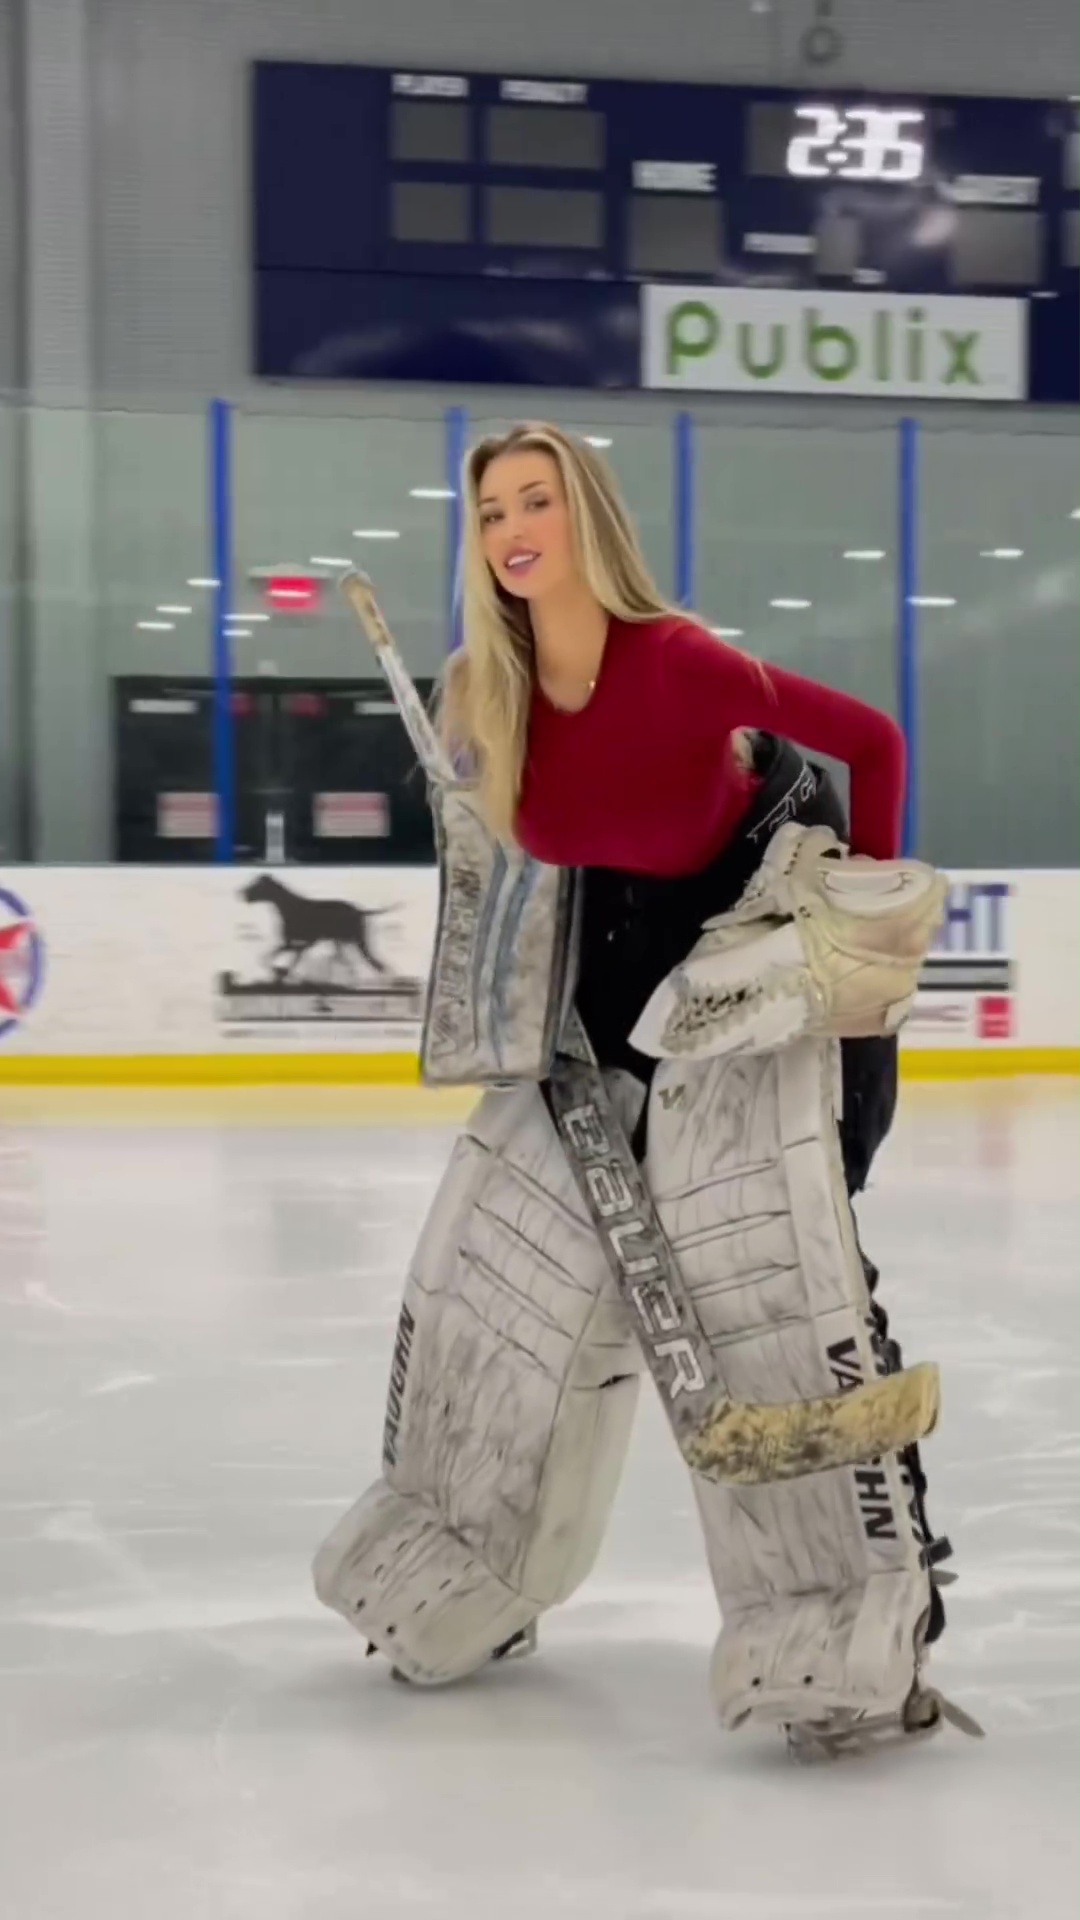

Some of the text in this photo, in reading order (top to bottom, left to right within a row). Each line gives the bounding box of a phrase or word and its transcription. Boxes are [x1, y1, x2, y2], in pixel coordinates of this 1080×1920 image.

[787, 107, 925, 180] 2:36
[665, 300, 983, 385] Publix
[384, 1302, 415, 1467] VAUGHN
[826, 1335, 898, 1540] VAHN
